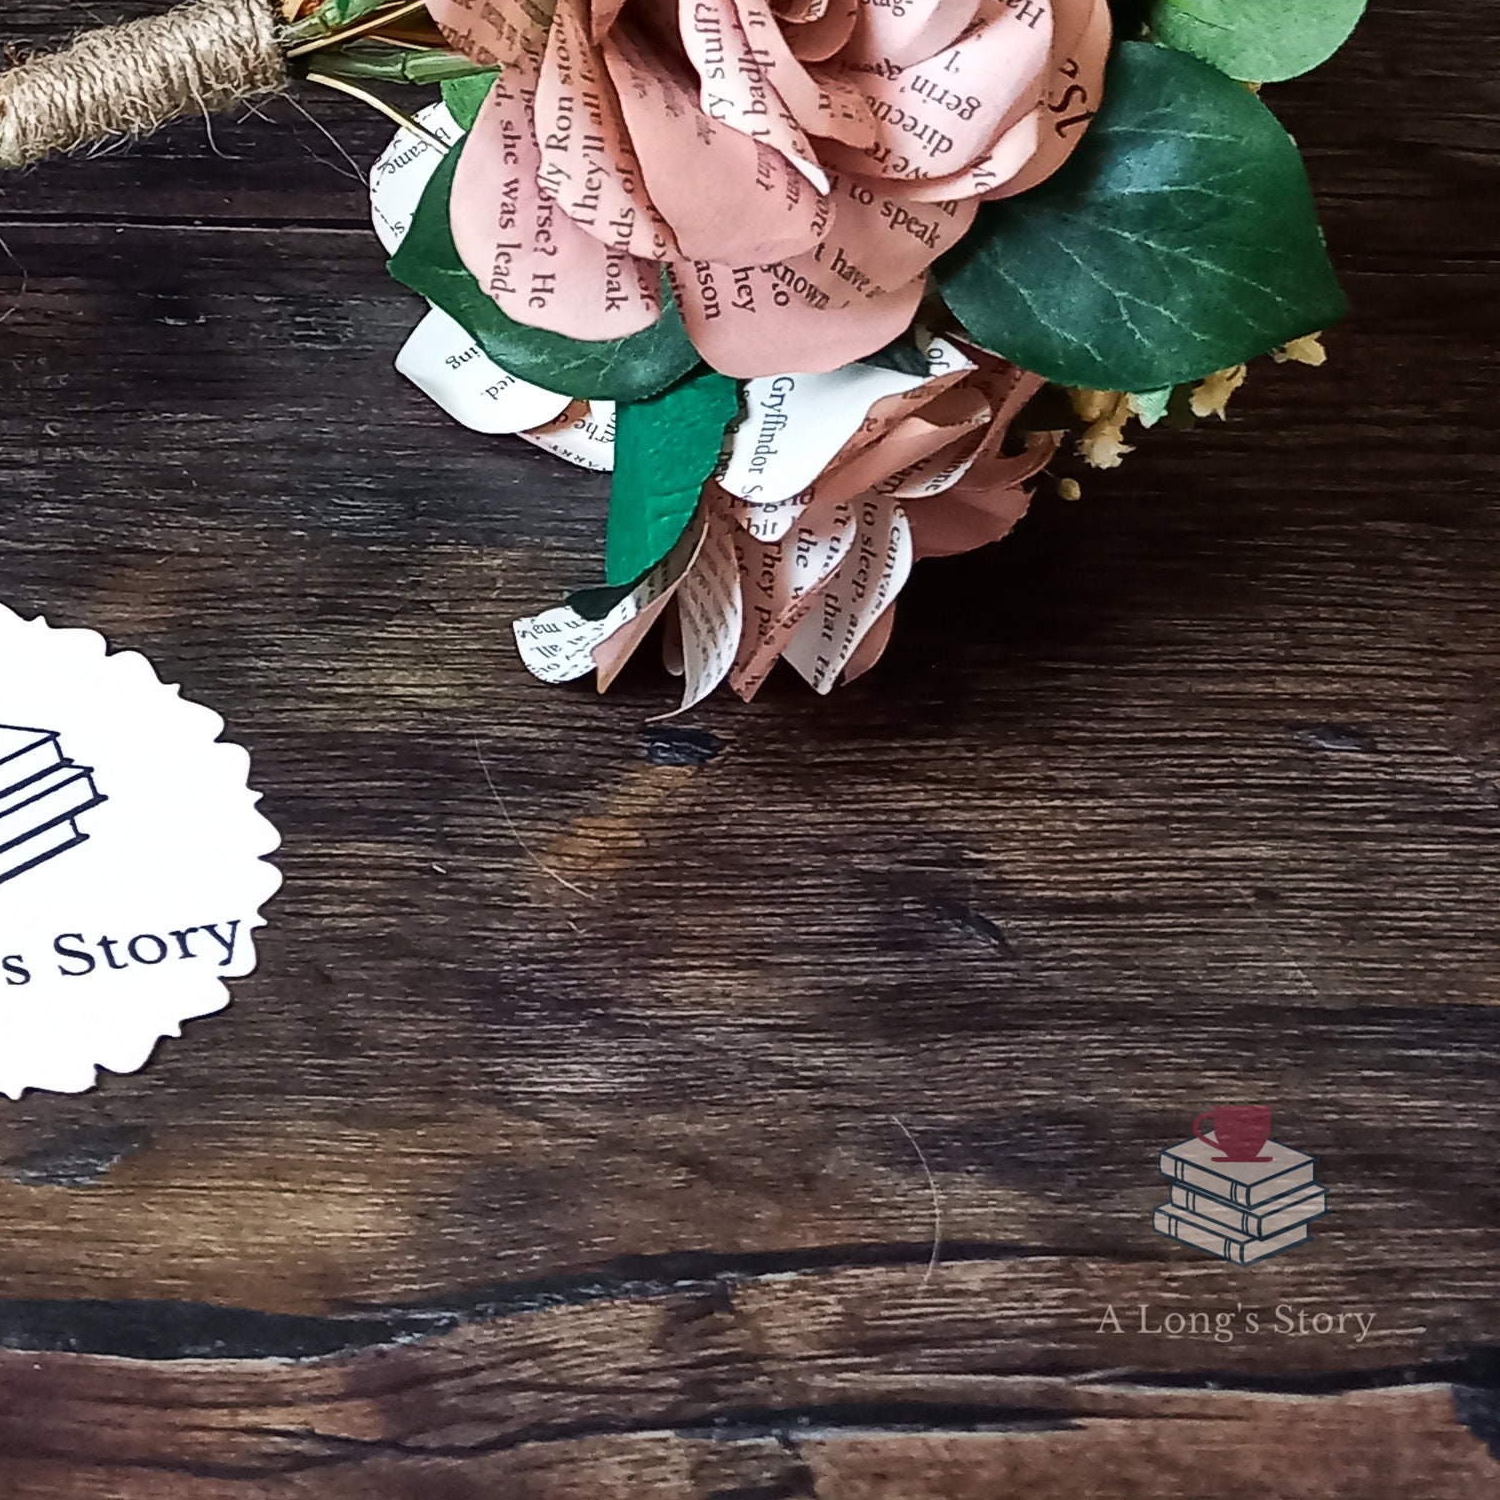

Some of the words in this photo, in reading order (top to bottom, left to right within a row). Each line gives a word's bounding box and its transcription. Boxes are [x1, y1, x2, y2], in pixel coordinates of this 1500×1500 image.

[694, 2, 726, 80] stuff?
[501, 119, 522, 166] she
[545, 97, 574, 152] Ron
[500, 177, 520, 229] was
[850, 182, 873, 205] to
[880, 200, 941, 250] speak
[490, 242, 522, 300] lead-
[528, 272, 556, 309] He
[748, 377, 795, 474] Gryffindor
[795, 527, 818, 568] the
[53, 919, 241, 978] Story
